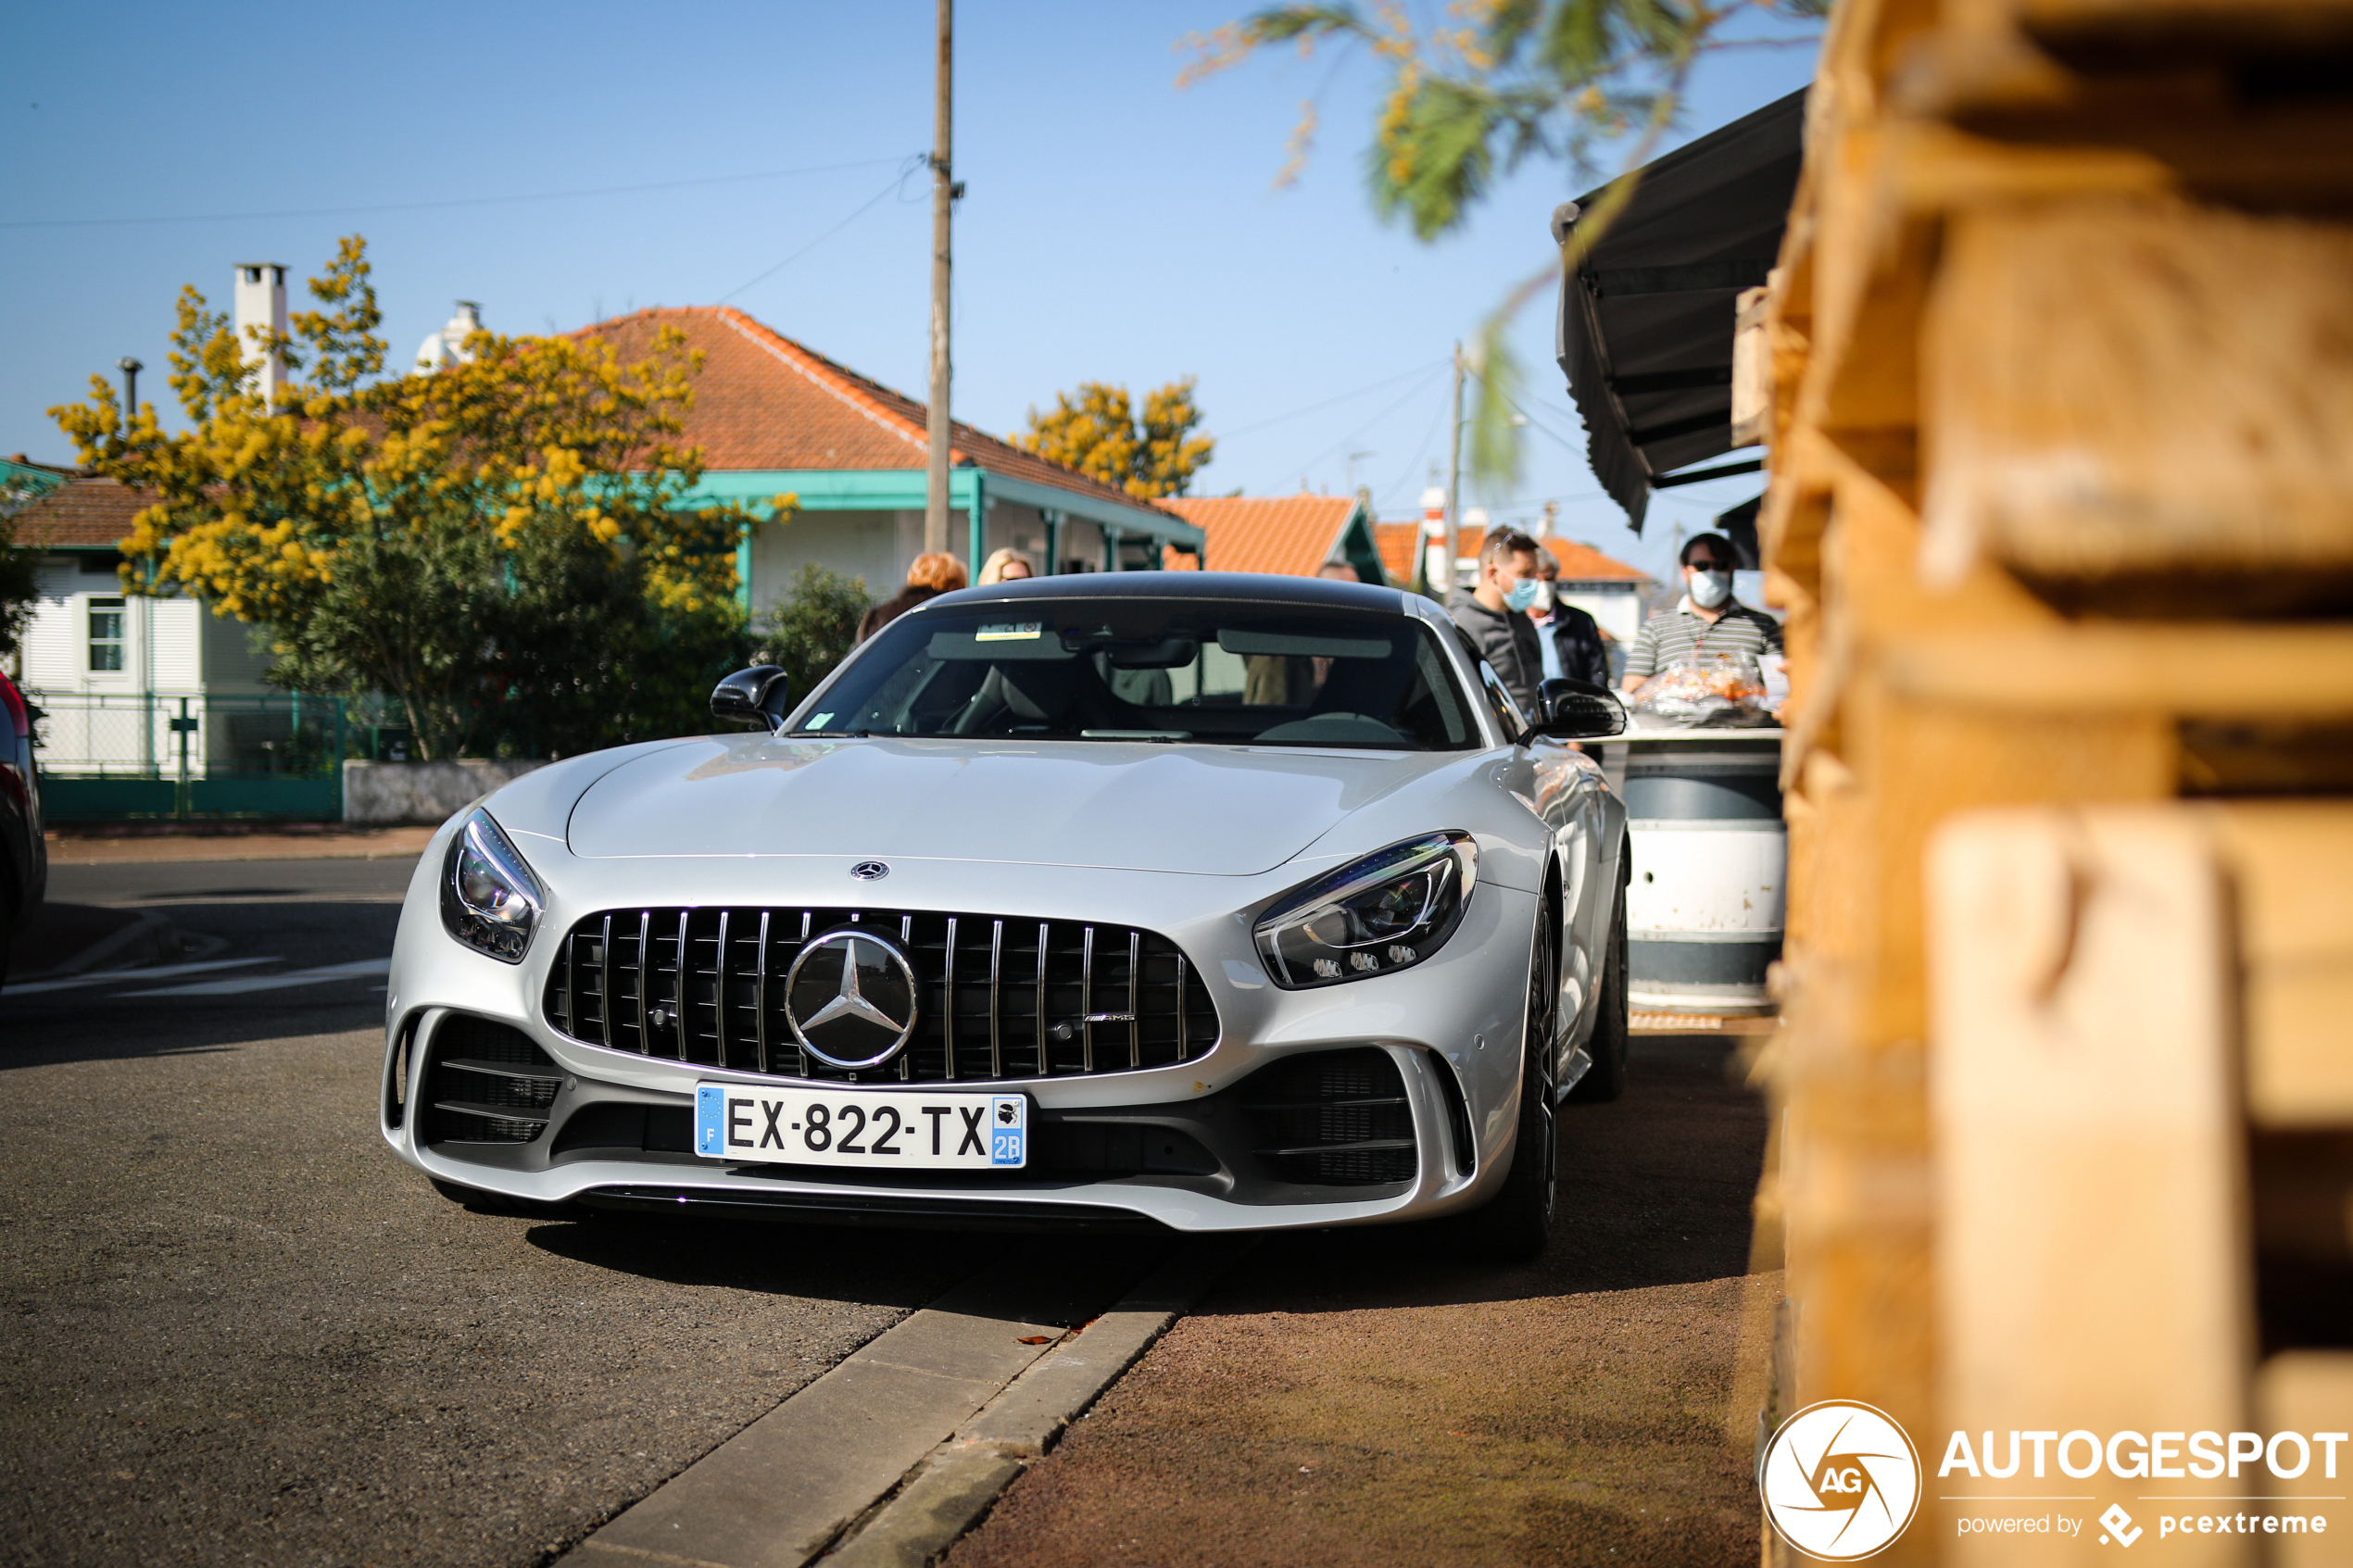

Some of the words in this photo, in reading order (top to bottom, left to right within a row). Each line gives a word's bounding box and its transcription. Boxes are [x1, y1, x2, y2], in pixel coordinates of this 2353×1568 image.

[707, 1128, 715, 1142] F
[728, 1098, 986, 1156] EX-822-TX
[994, 1135, 1021, 1160] 2B
